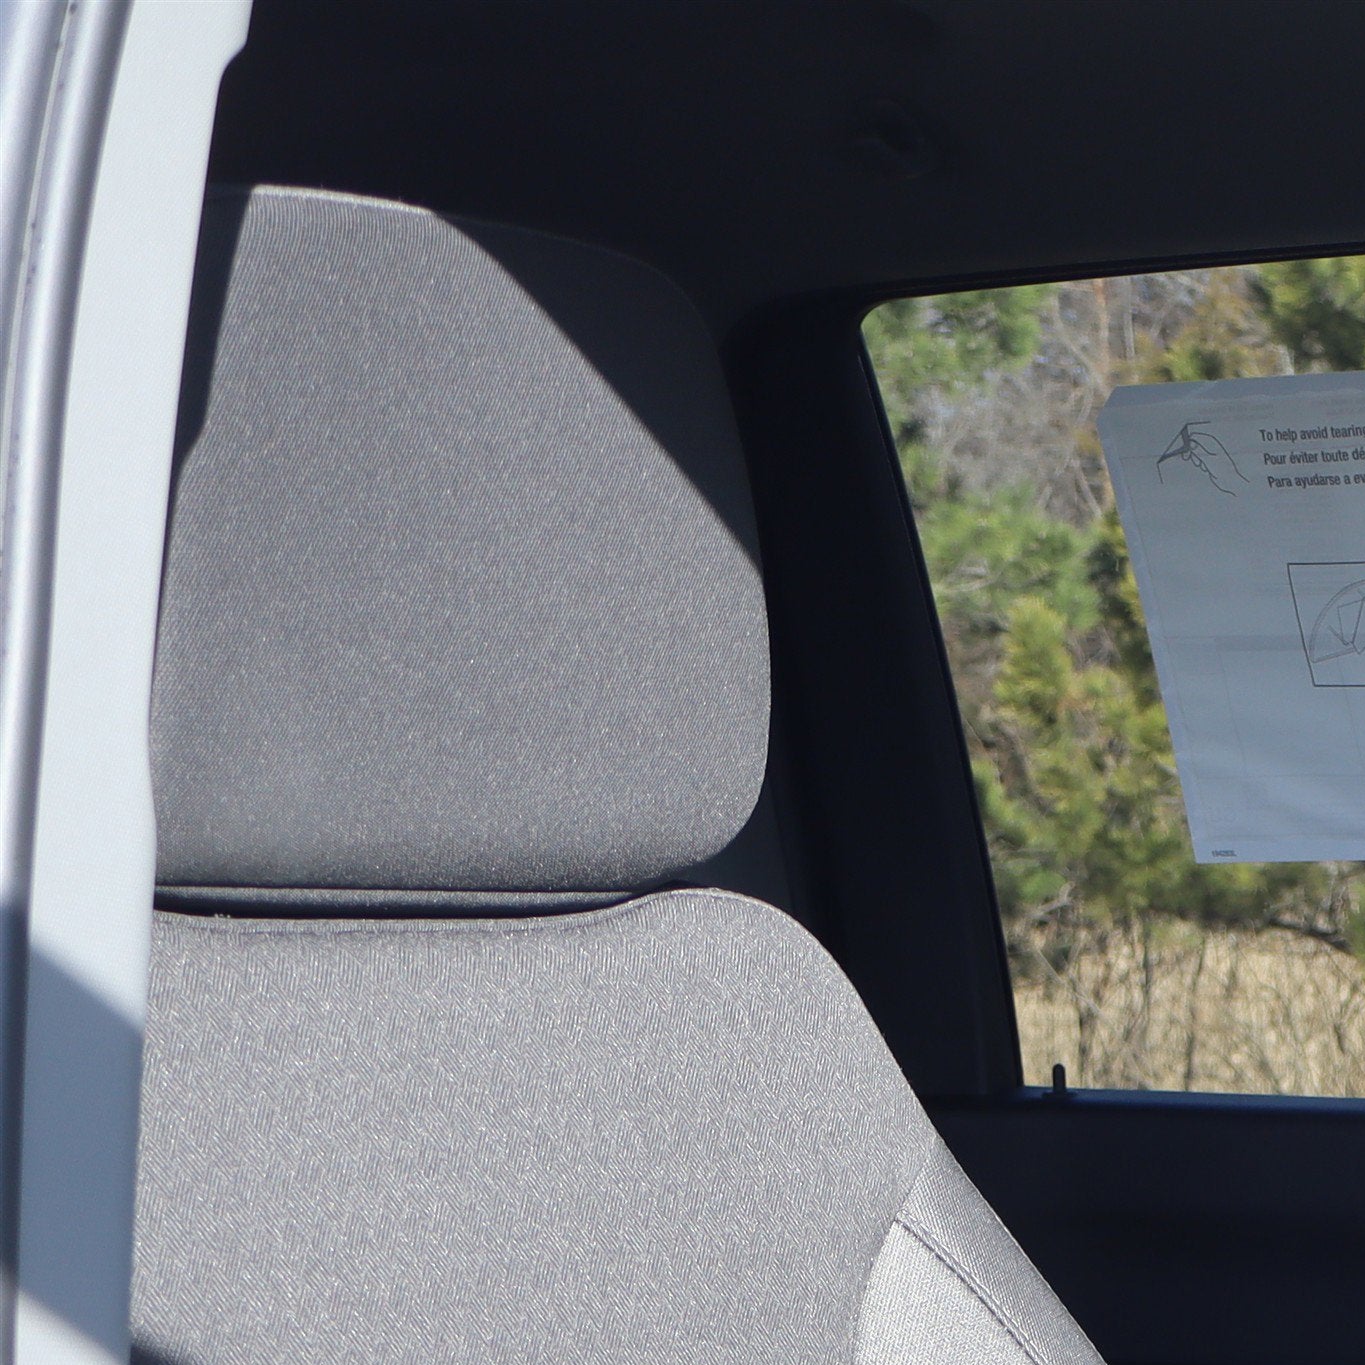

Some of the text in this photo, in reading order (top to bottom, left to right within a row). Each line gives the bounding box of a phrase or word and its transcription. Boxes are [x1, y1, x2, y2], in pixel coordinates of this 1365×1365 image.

[1258, 429, 1274, 442] To
[1275, 428, 1298, 444] help
[1300, 426, 1329, 441] avoid
[1263, 452, 1287, 466] Pour
[1289, 451, 1319, 465] éviter
[1320, 449, 1350, 463] toute
[1266, 475, 1293, 489] Para
[1294, 473, 1342, 490] ayudarse
[1343, 474, 1352, 485] a
